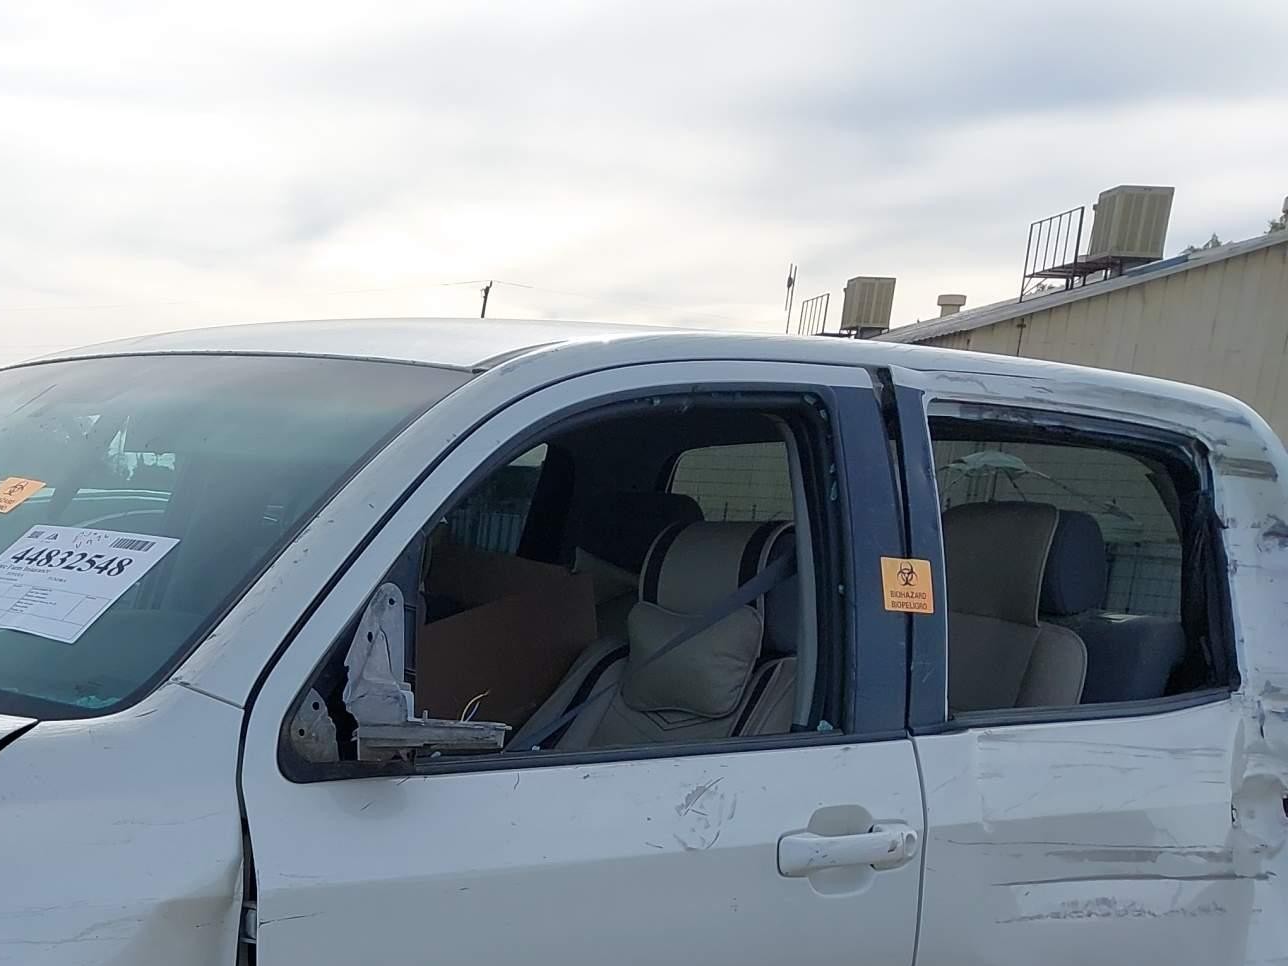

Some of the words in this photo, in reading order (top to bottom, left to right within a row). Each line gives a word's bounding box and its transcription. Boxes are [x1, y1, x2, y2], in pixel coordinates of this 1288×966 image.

[11, 547, 133, 576] 44832548
[890, 591, 927, 600] BIOHAZARD
[892, 601, 928, 610] BIOPELIGRO
